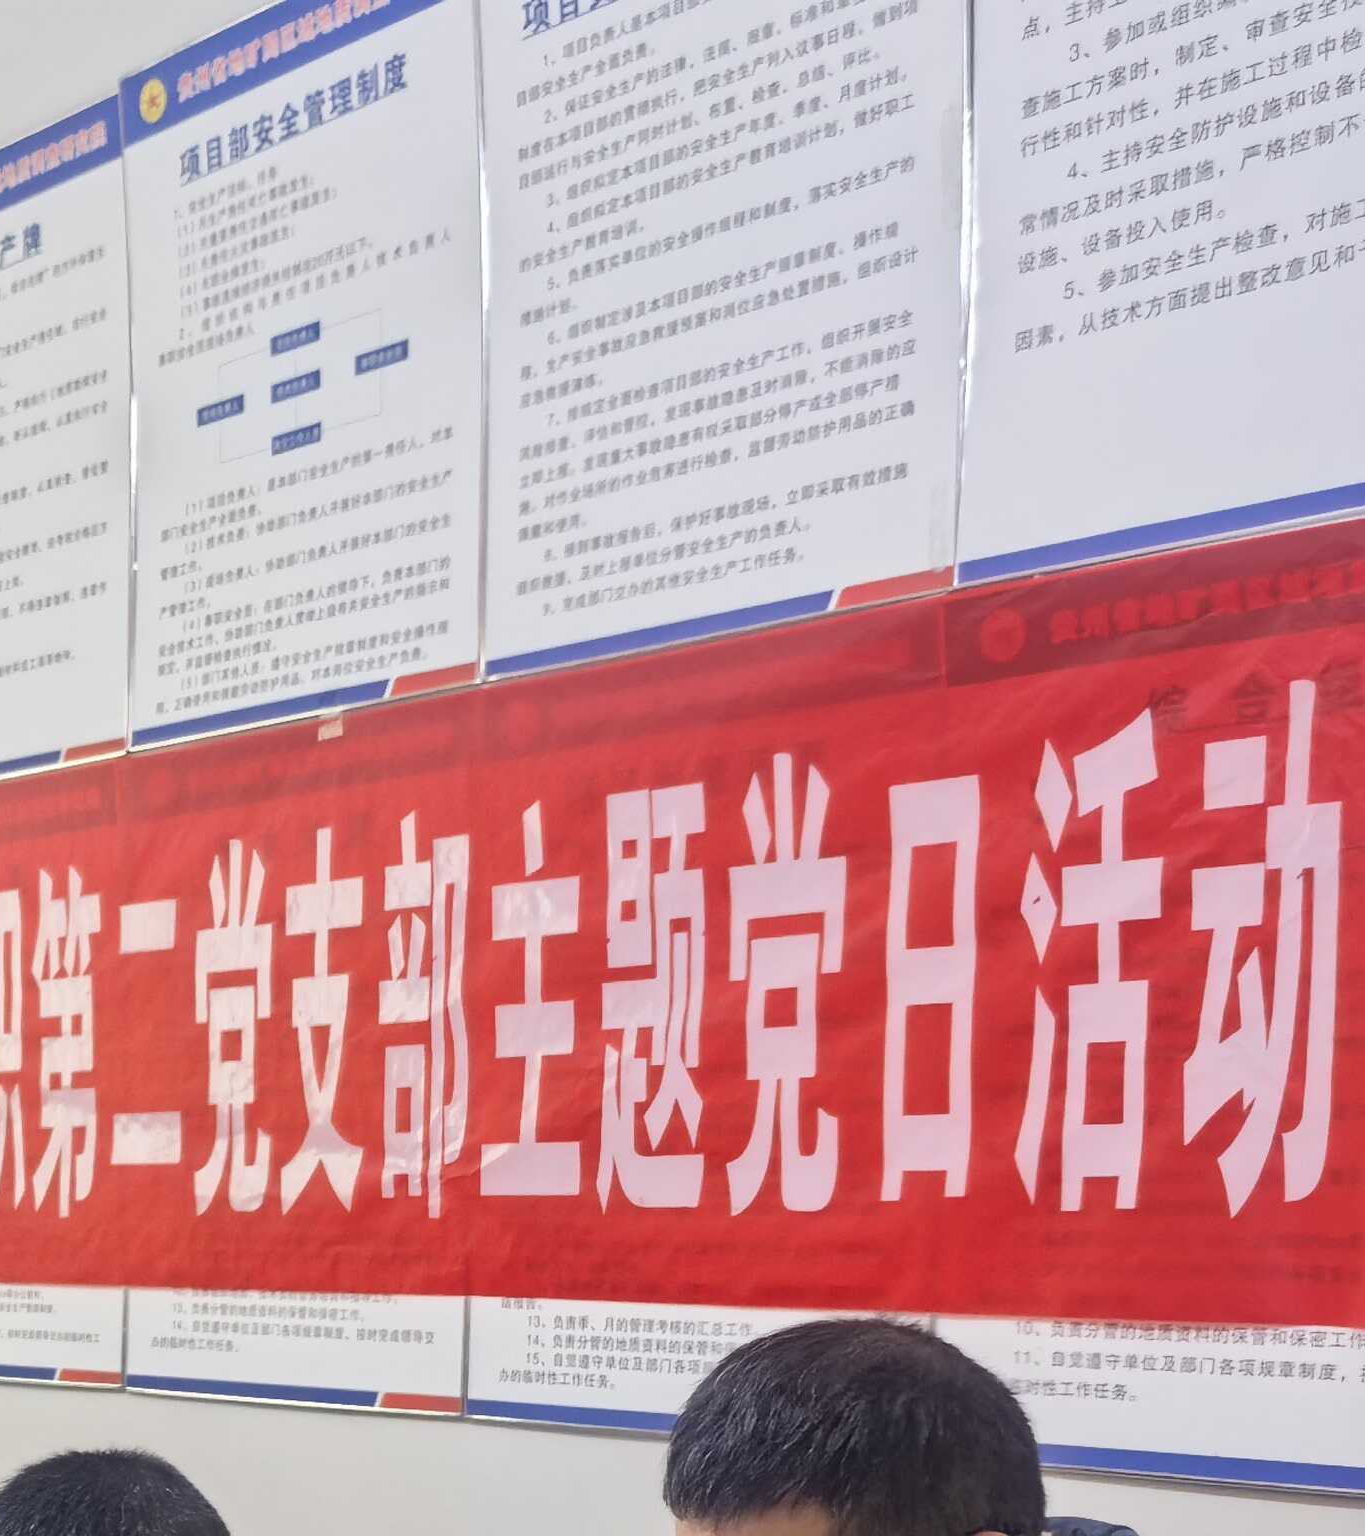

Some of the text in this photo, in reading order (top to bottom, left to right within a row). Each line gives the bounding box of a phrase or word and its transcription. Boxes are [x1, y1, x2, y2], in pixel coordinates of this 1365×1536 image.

[180, 53, 408, 183] 项目部安全管理制度
[1019, 113, 1365, 237] 常情况及时采取措施，严格控制不
[1067, 67, 1365, 180] 4、主持安全防护设施和设备
